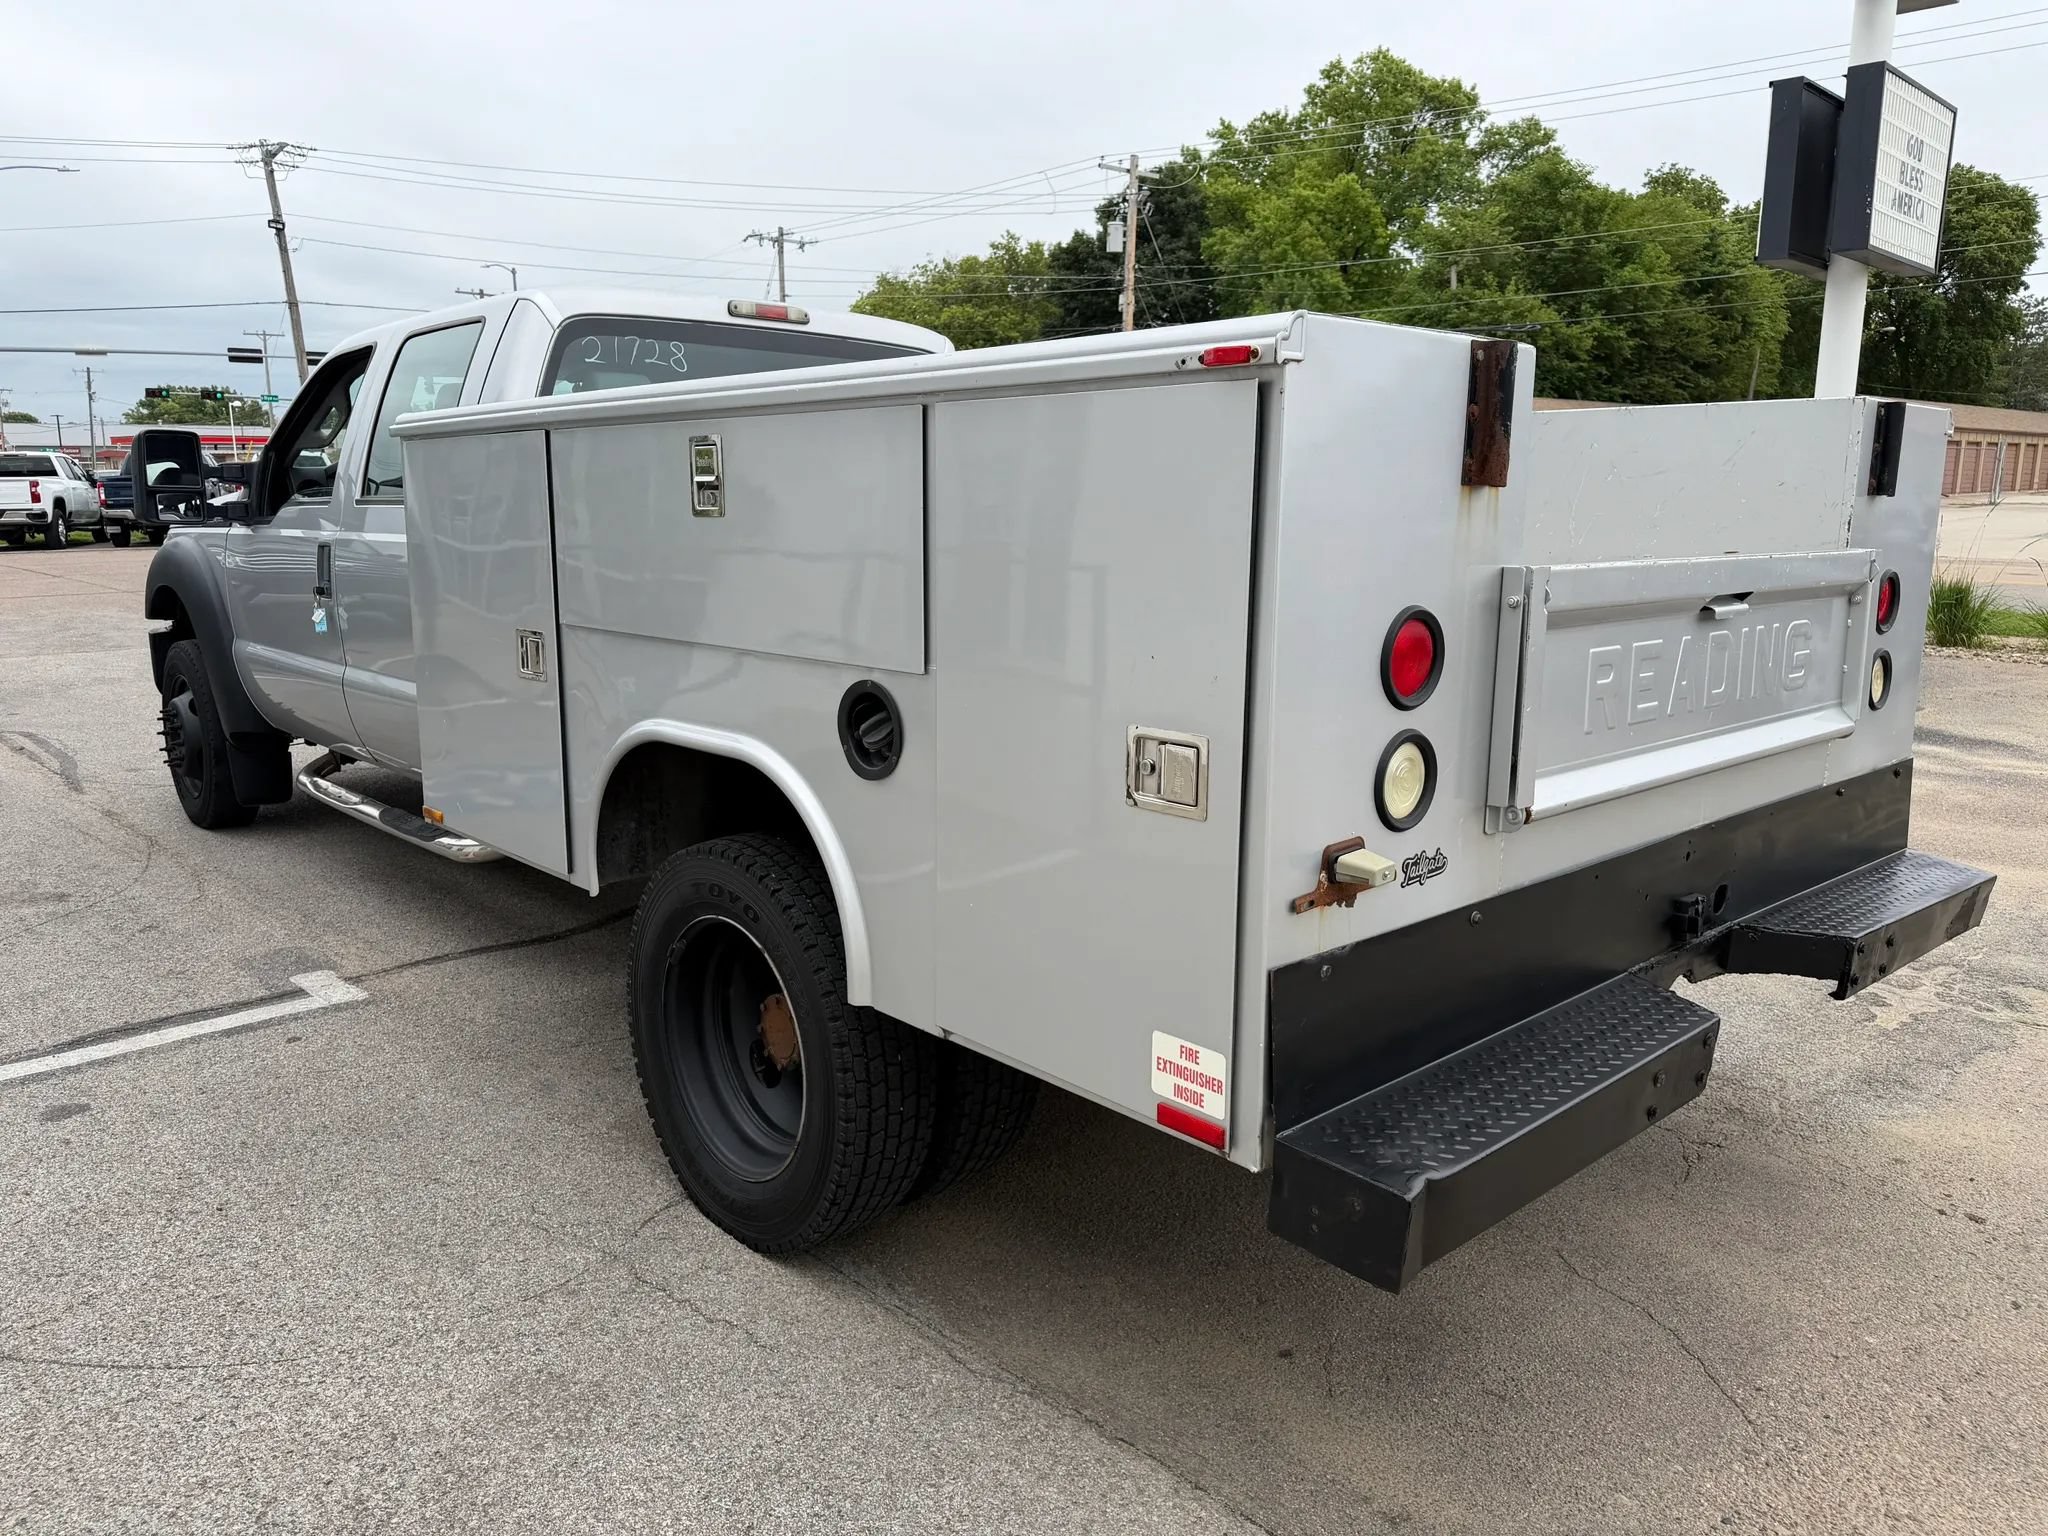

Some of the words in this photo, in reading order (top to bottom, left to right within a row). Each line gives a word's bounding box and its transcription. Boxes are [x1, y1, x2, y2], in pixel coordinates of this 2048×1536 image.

[1907, 134, 1924, 163] GOD
[1900, 161, 1925, 193] BLESS
[1891, 188, 1924, 224] AMERICA
[581, 336, 688, 372] 21728
[1584, 619, 1812, 735] READING
[691, 881, 760, 924] TOYO
[1179, 1044, 1200, 1065] FIRE
[1156, 1056, 1224, 1096] EXTINGUISHER
[1173, 1083, 1205, 1109] INSIDE
